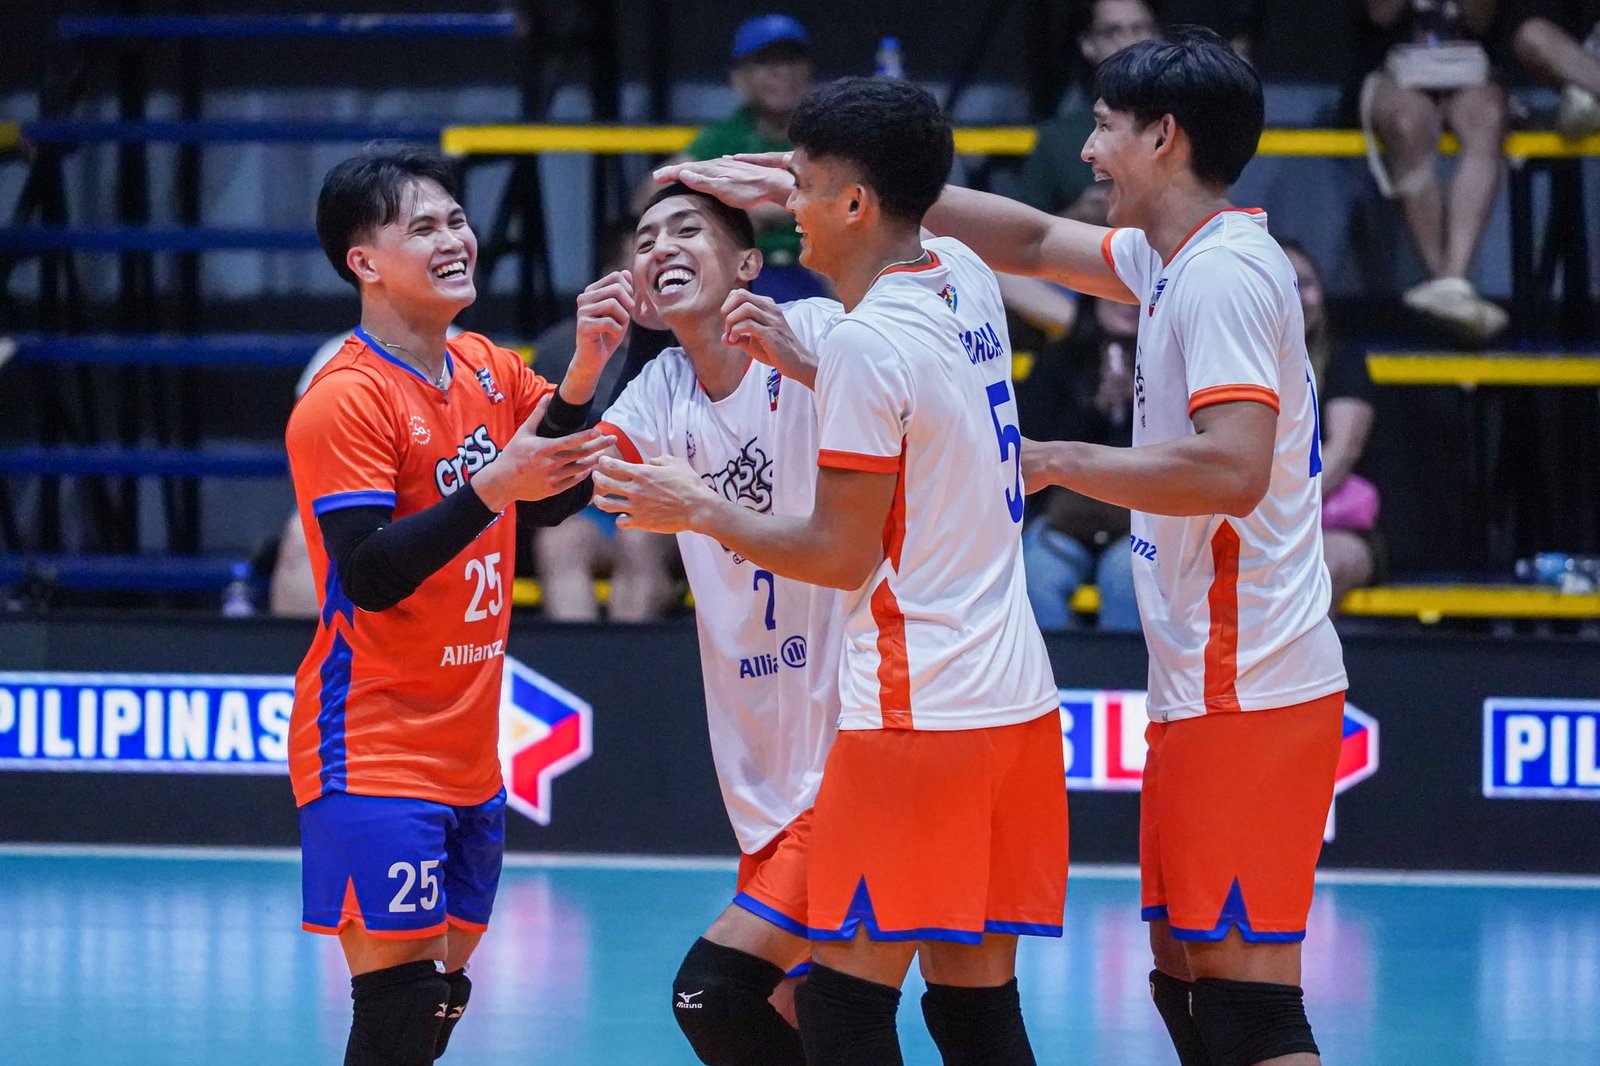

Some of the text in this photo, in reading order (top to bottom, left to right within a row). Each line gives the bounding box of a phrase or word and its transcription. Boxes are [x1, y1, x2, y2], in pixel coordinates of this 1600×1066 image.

[985, 379, 1024, 523] 5
[464, 551, 503, 622] 25
[440, 639, 504, 667] Allianz
[1505, 714, 1600, 787] PIL
[387, 859, 440, 913] 25
